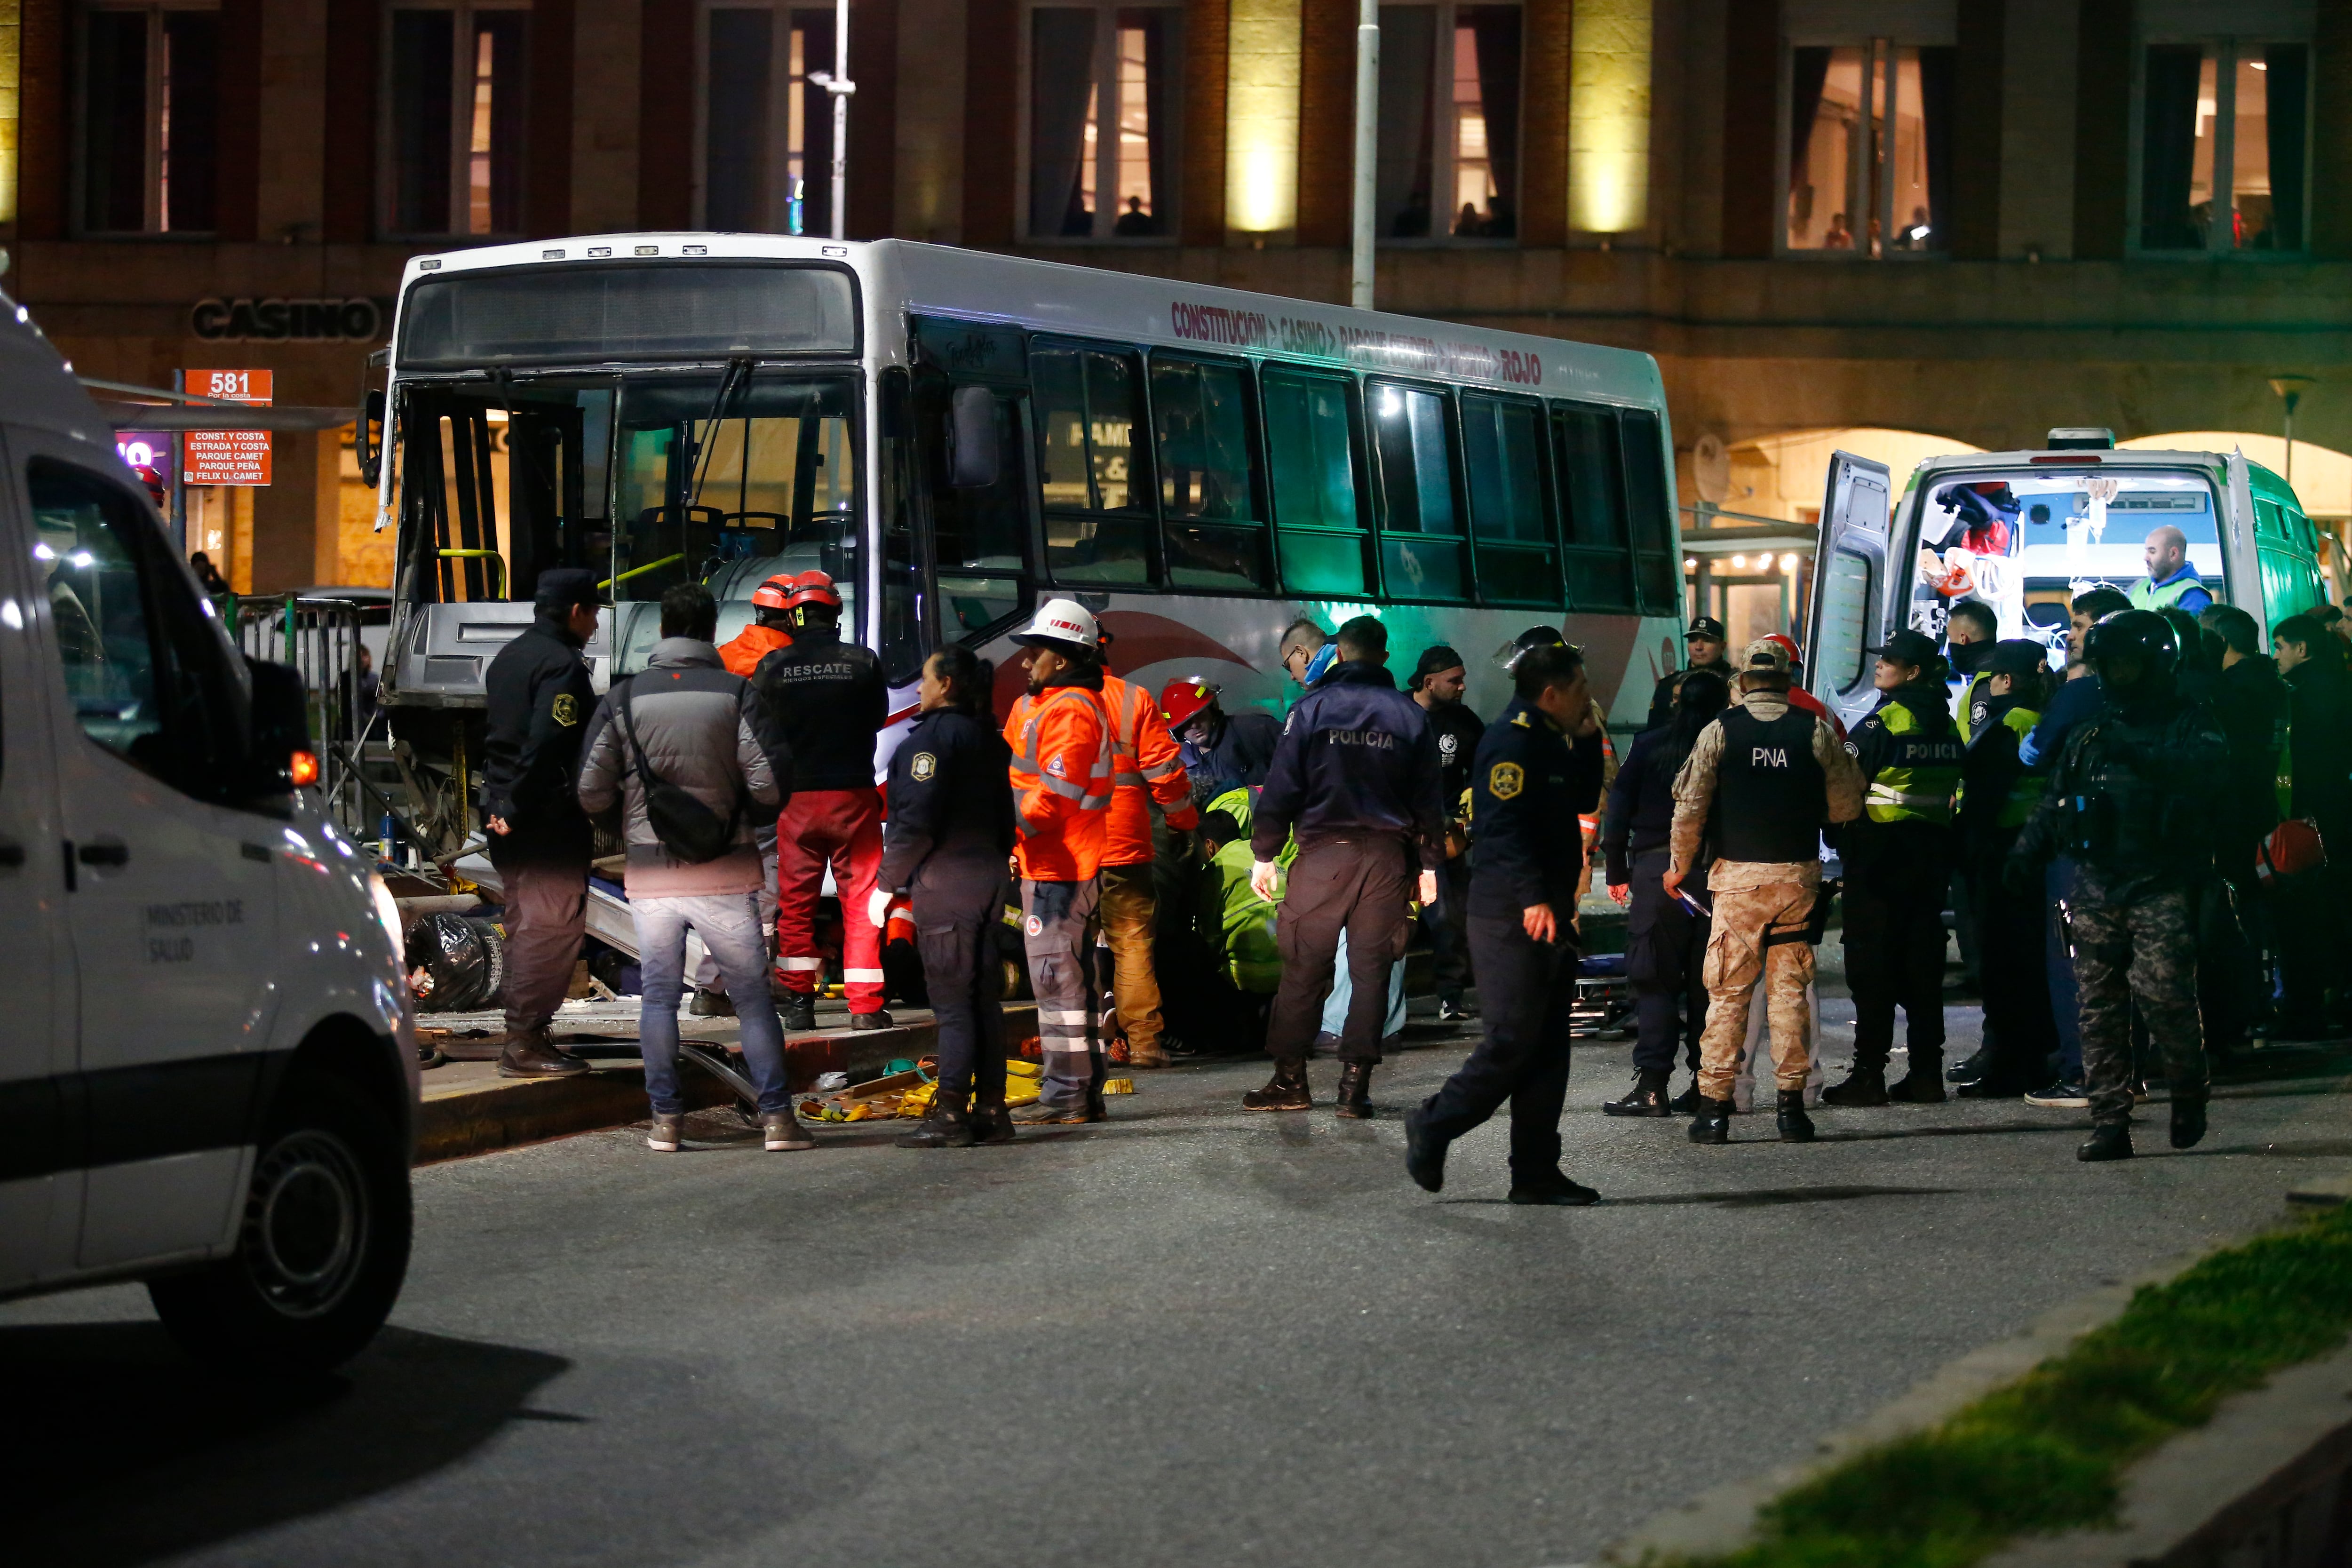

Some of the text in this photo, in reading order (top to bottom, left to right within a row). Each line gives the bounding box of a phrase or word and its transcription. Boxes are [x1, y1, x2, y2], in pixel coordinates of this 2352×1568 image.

[190, 300, 379, 342] CASINO
[1280, 316, 1327, 357] CASINO
[1500, 349, 1542, 386] ROJO
[210, 372, 249, 394] 581
[190, 442, 270, 451] ESTRADA Y COSTA
[196, 452, 264, 461] PARQUE CAMET
[237, 461, 261, 470] PEÑA
[783, 663, 851, 677] RESCATE
[1329, 730, 1394, 749] POLICIA
[1752, 747, 1788, 768] PNA
[147, 899, 244, 926] MINISTERIO DE
[149, 937, 194, 963] SALUD
